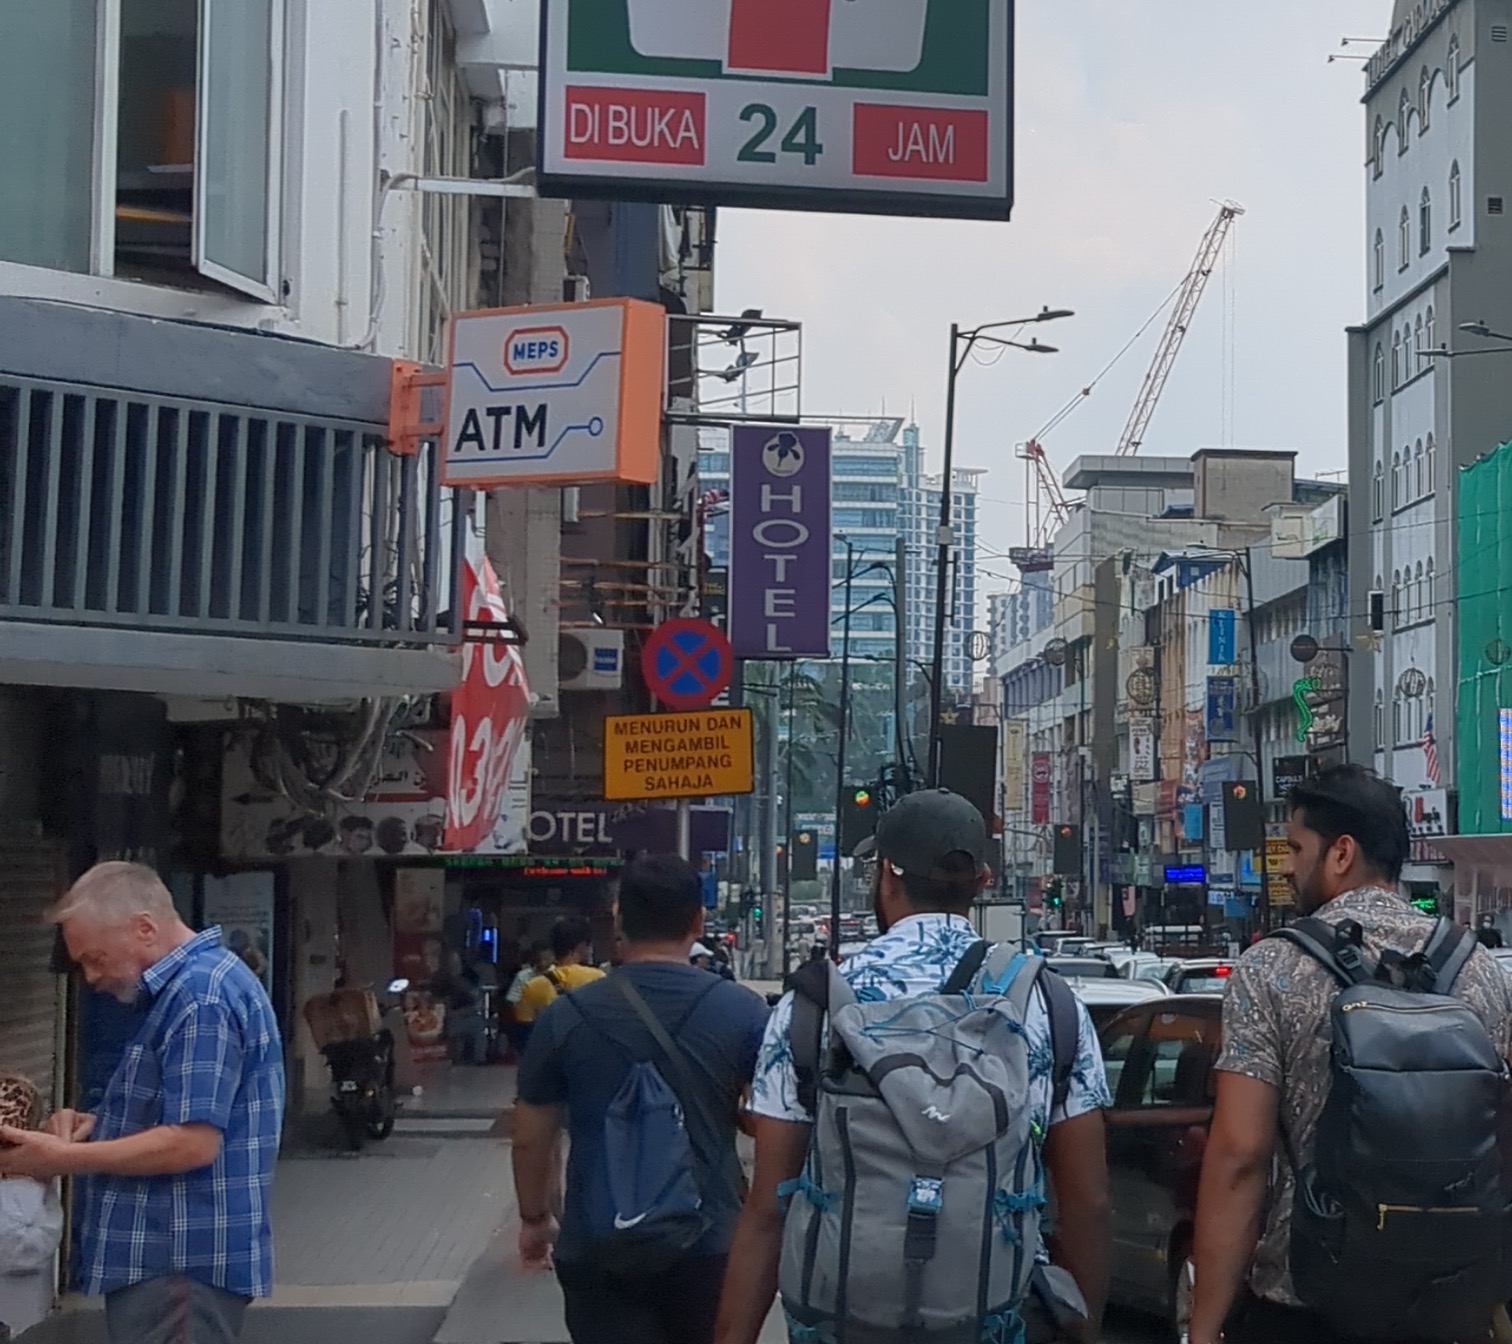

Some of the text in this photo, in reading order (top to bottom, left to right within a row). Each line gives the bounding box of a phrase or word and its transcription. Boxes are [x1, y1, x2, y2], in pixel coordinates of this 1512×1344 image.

[736, 103, 823, 166] 24
[887, 121, 955, 164] JAM
[512, 338, 559, 361] MEPS
[454, 403, 548, 453] ATM
[752, 483, 810, 653] HOTEL
[614, 716, 742, 736] MENURUN DAN
[625, 737, 730, 754] MENGAMBIL
[624, 755, 732, 773] PENUMPANG
[645, 774, 714, 792] SAHAJA
[527, 809, 614, 845] OTEL
